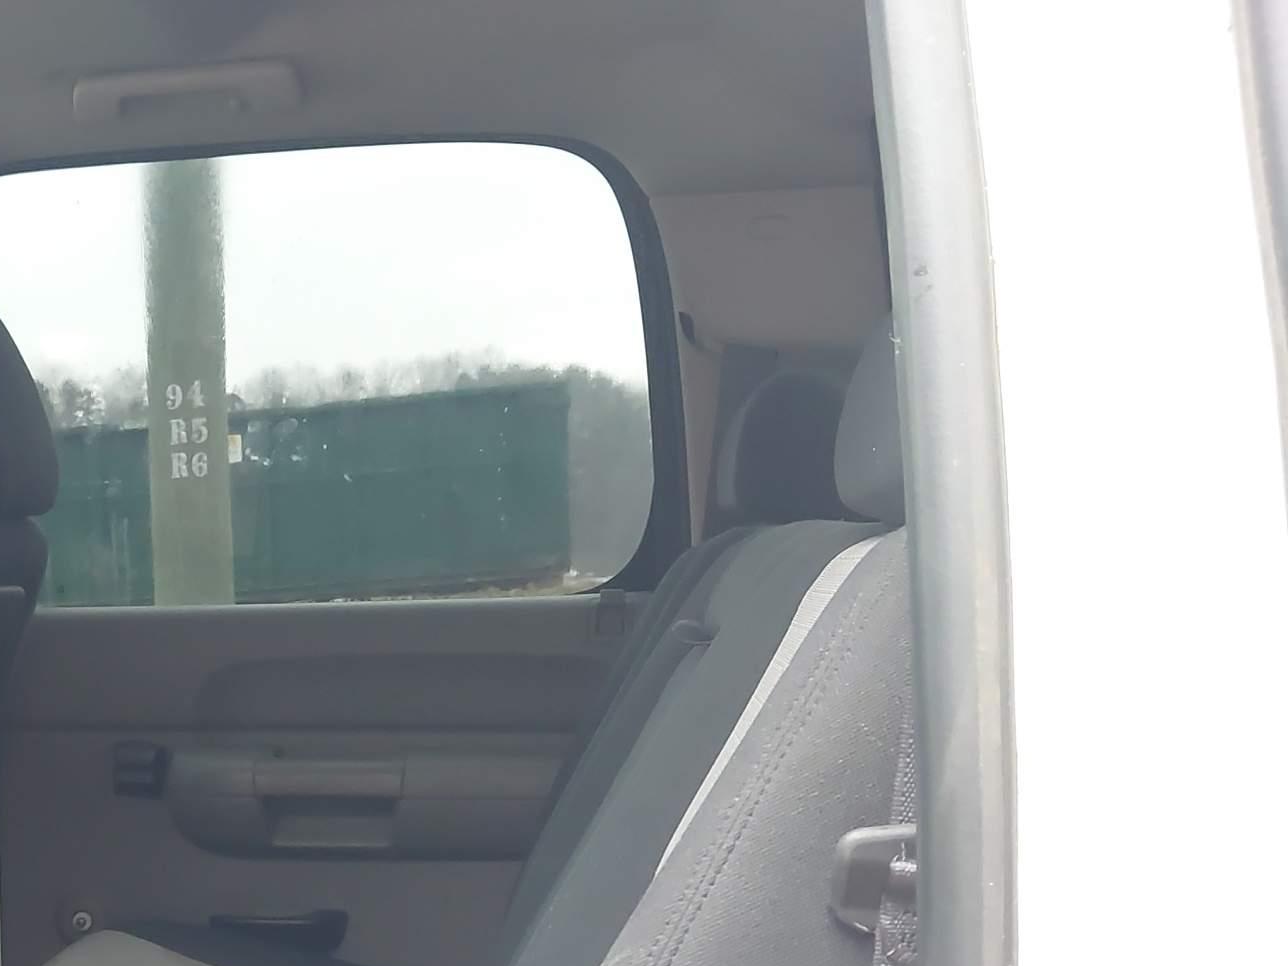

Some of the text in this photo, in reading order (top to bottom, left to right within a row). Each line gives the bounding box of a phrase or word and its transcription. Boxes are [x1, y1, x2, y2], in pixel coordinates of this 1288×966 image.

[165, 380, 206, 410] 94
[169, 417, 209, 446] R5
[170, 451, 209, 479] R6
